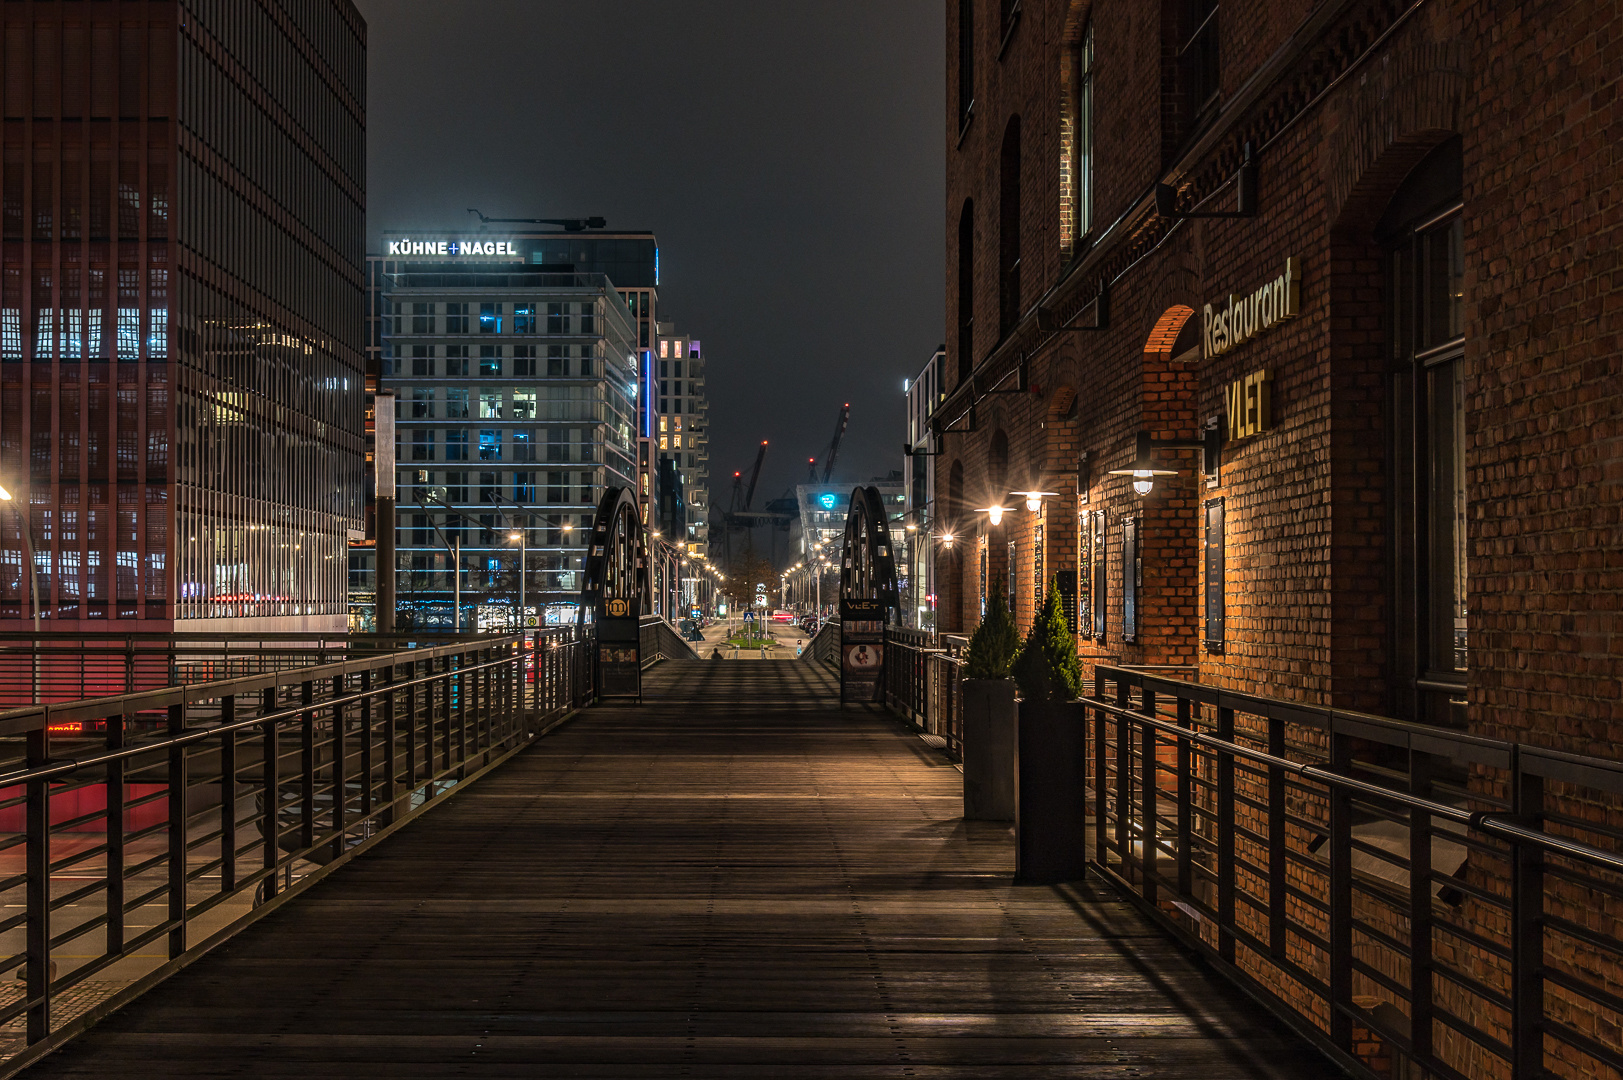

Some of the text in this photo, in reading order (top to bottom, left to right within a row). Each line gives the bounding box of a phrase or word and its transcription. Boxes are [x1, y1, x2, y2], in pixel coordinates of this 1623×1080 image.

[389, 239, 516, 255] KÜHNE+NAGEL
[1203, 256, 1297, 360] Restaurant
[1225, 368, 1269, 442] VLET
